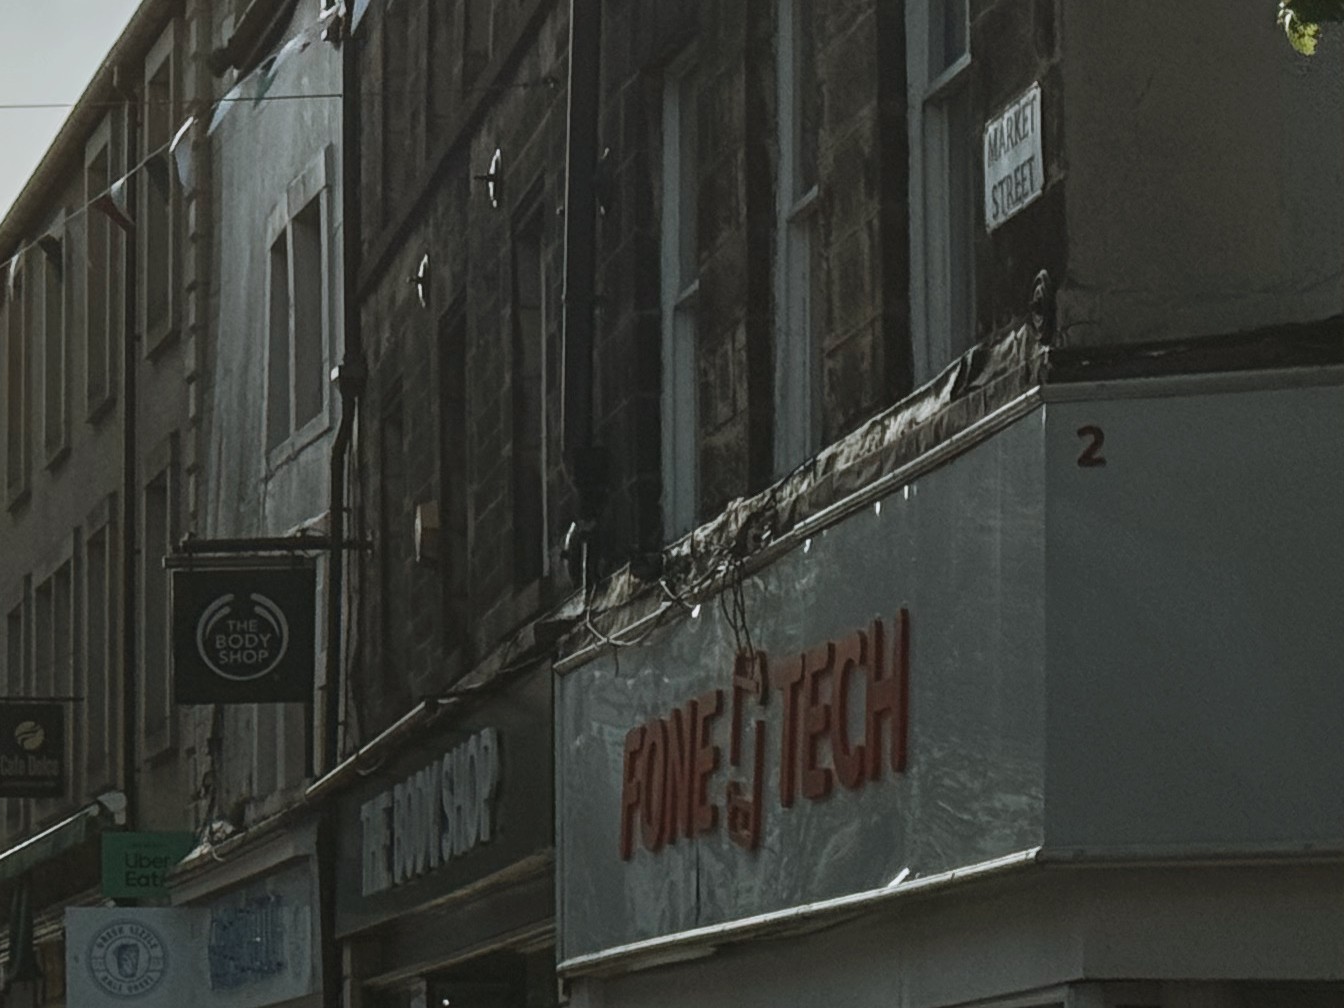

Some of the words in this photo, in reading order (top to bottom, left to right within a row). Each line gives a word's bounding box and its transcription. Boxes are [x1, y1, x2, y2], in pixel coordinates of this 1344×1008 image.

[987, 94, 1037, 168] MARKET
[991, 156, 1036, 221] STREET
[1077, 425, 1107, 467] 2
[215, 633, 271, 649] BODY
[227, 619, 258, 632] THE
[219, 650, 269, 664] SHOP
[621, 689, 724, 862] FONE
[774, 606, 912, 810] TECH
[361, 790, 392, 897] THE
[393, 760, 442, 886] BODY
[441, 727, 499, 864] SHOP
[125, 851, 171, 869] Uber
